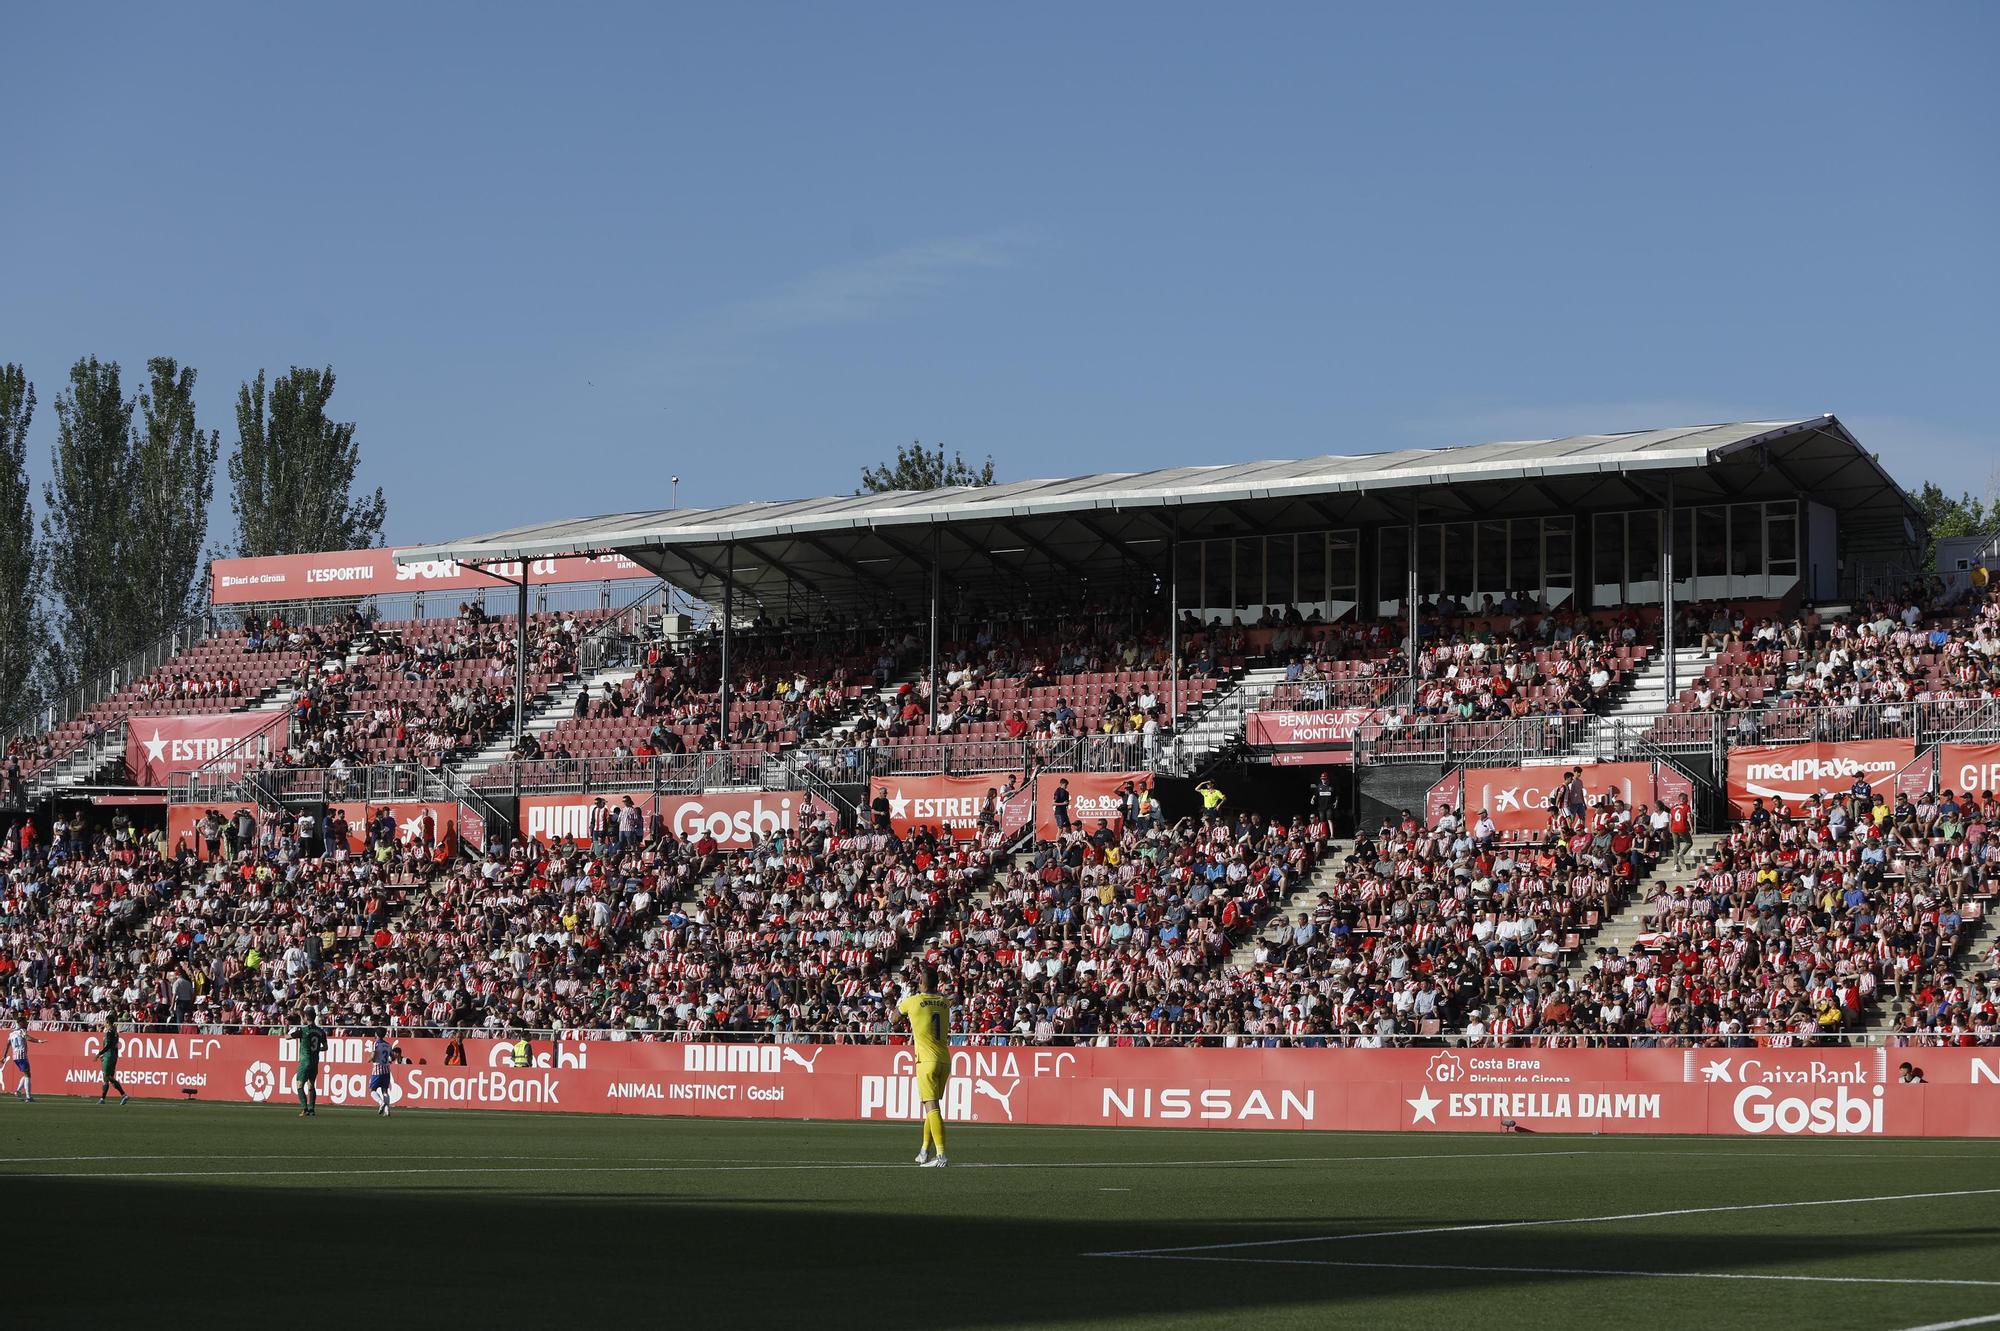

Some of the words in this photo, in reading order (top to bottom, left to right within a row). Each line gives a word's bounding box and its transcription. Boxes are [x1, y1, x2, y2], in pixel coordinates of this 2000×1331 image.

[230, 576, 249, 585] Diari
[250, 575, 259, 584] de
[260, 574, 286, 583] Girona
[395, 559, 464, 580] SPORT
[1279, 713, 1360, 727] BENVINGUTS
[1293, 728, 1356, 740] MONTILIV
[528, 805, 602, 840] PUM
[673, 798, 791, 843] Gosbi
[1674, 809, 1681, 822] 6
[931, 1013, 941, 1041] 1
[84, 1036, 179, 1059] GRONA
[310, 1036, 319, 1051] 3
[893, 1050, 1020, 1077] GONA
[1469, 1058, 1503, 1069] Costa
[1506, 1058, 1541, 1069] Brava
[1738, 1060, 1868, 1083] CaixaBank
[65, 1068, 104, 1083] ANIMA
[116, 1071, 168, 1085] RESPECT
[176, 1072, 207, 1087] Gosbi
[407, 1069, 560, 1104] SmartBank
[607, 1082, 664, 1099] ANIMAL
[669, 1084, 736, 1100] INSTINCT
[747, 1085, 784, 1101] Gosbi
[1102, 1088, 1315, 1120] NISSAN
[1449, 1093, 1572, 1118] ESTRELLA
[1578, 1093, 1661, 1119] DAMM
[1733, 1084, 1885, 1133] Gosbi
